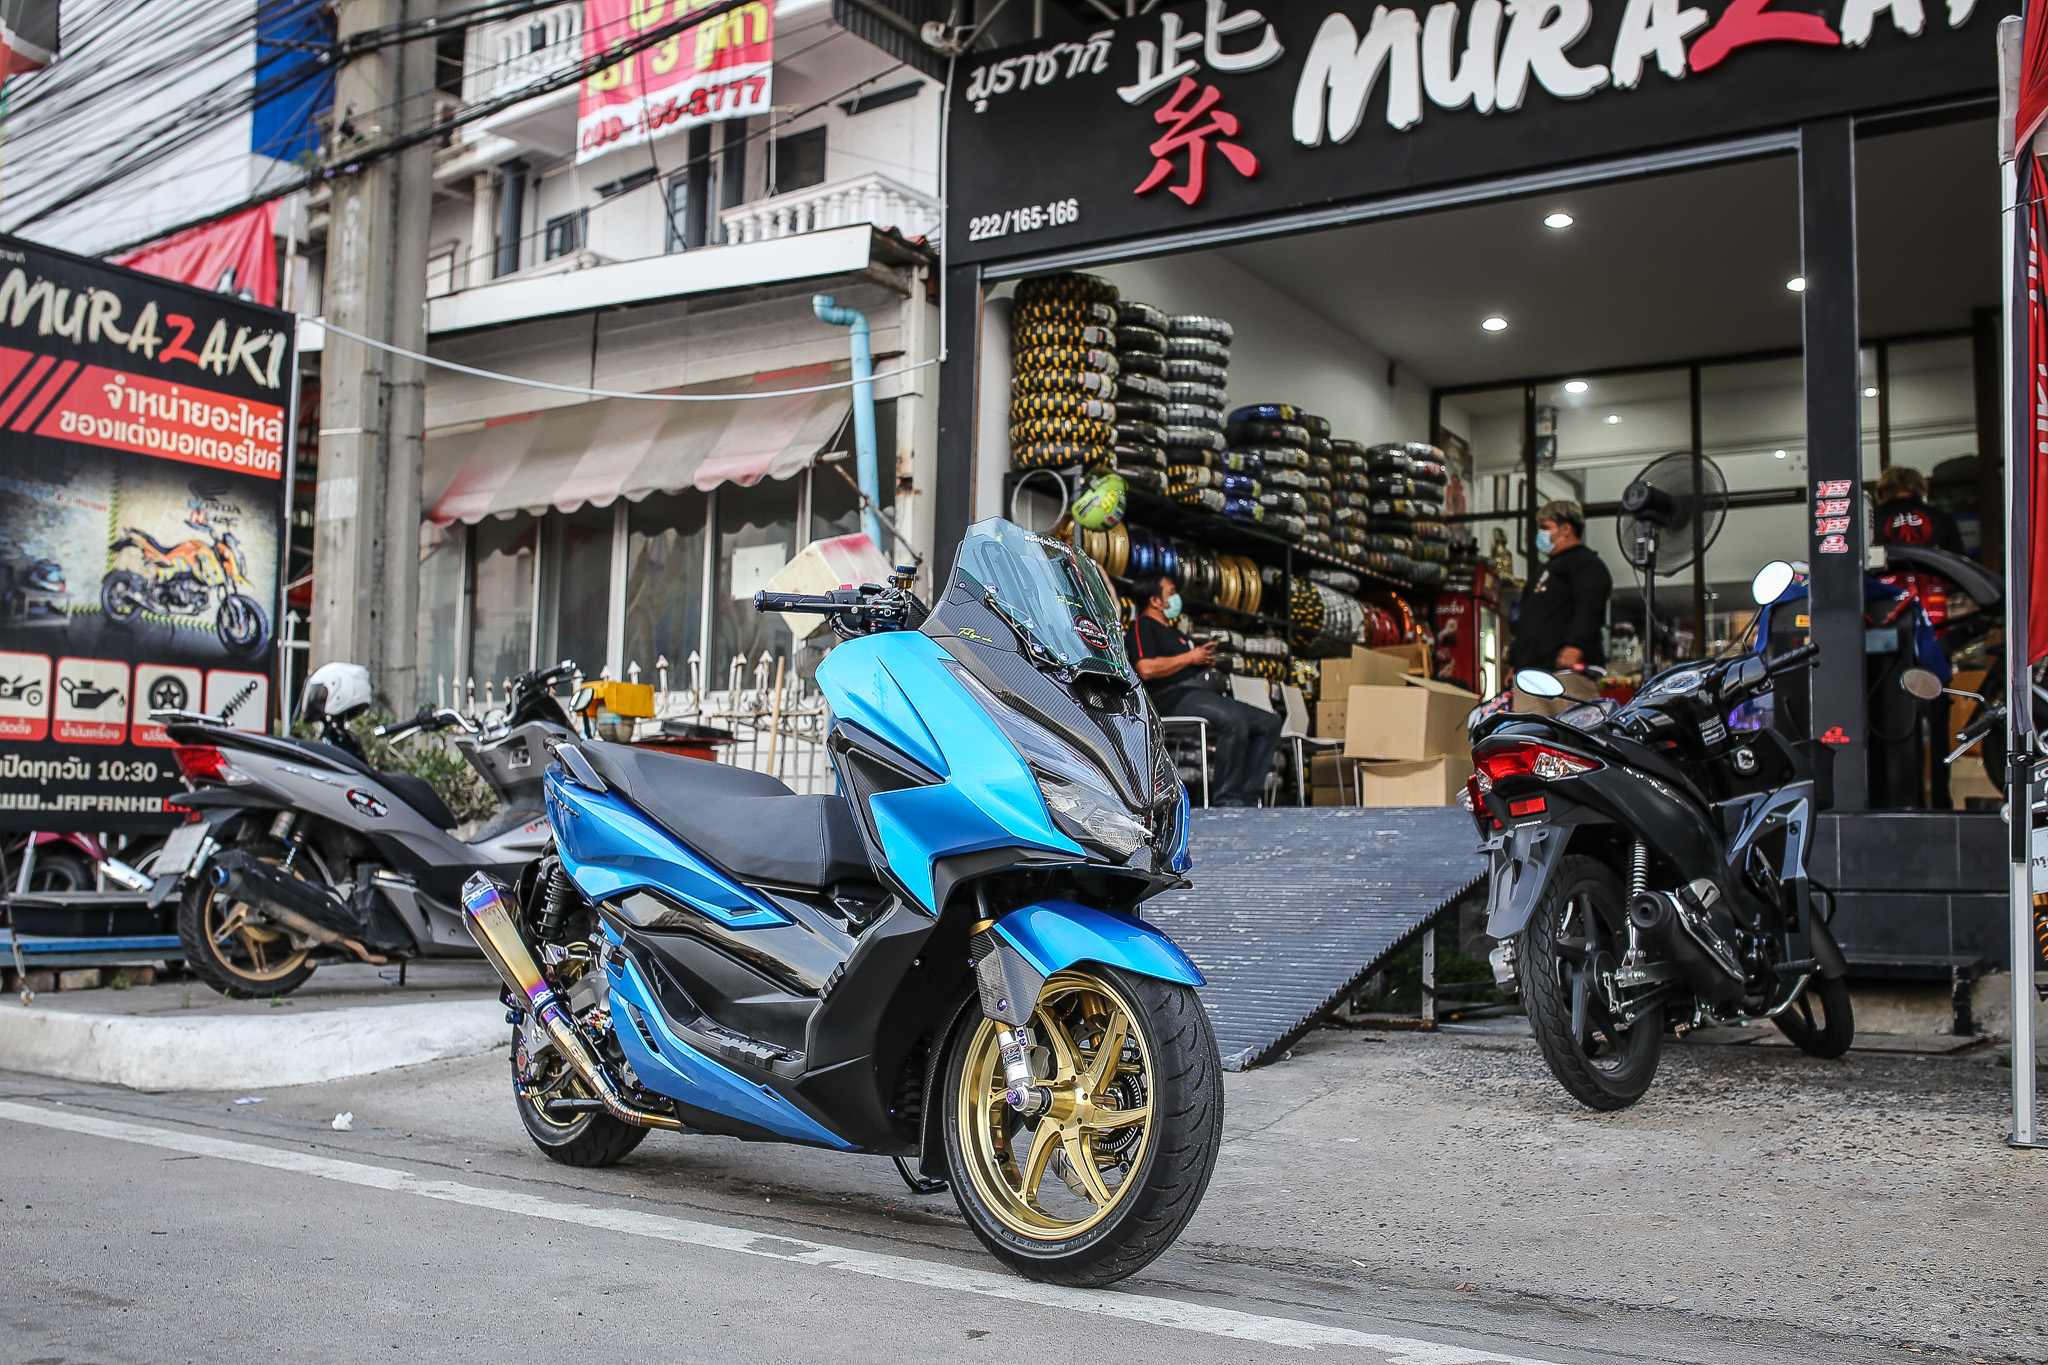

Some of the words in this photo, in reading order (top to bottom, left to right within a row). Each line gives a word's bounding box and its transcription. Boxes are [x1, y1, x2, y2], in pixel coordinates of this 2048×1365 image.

[1116, 0, 1285, 206] 紫
[968, 198, 1080, 241] 222/165-166
[0, 268, 287, 389] MURAZAKI
[103, 374, 285, 444] จำหน่ายอะไหล่
[97, 760, 158, 783] 10:30
